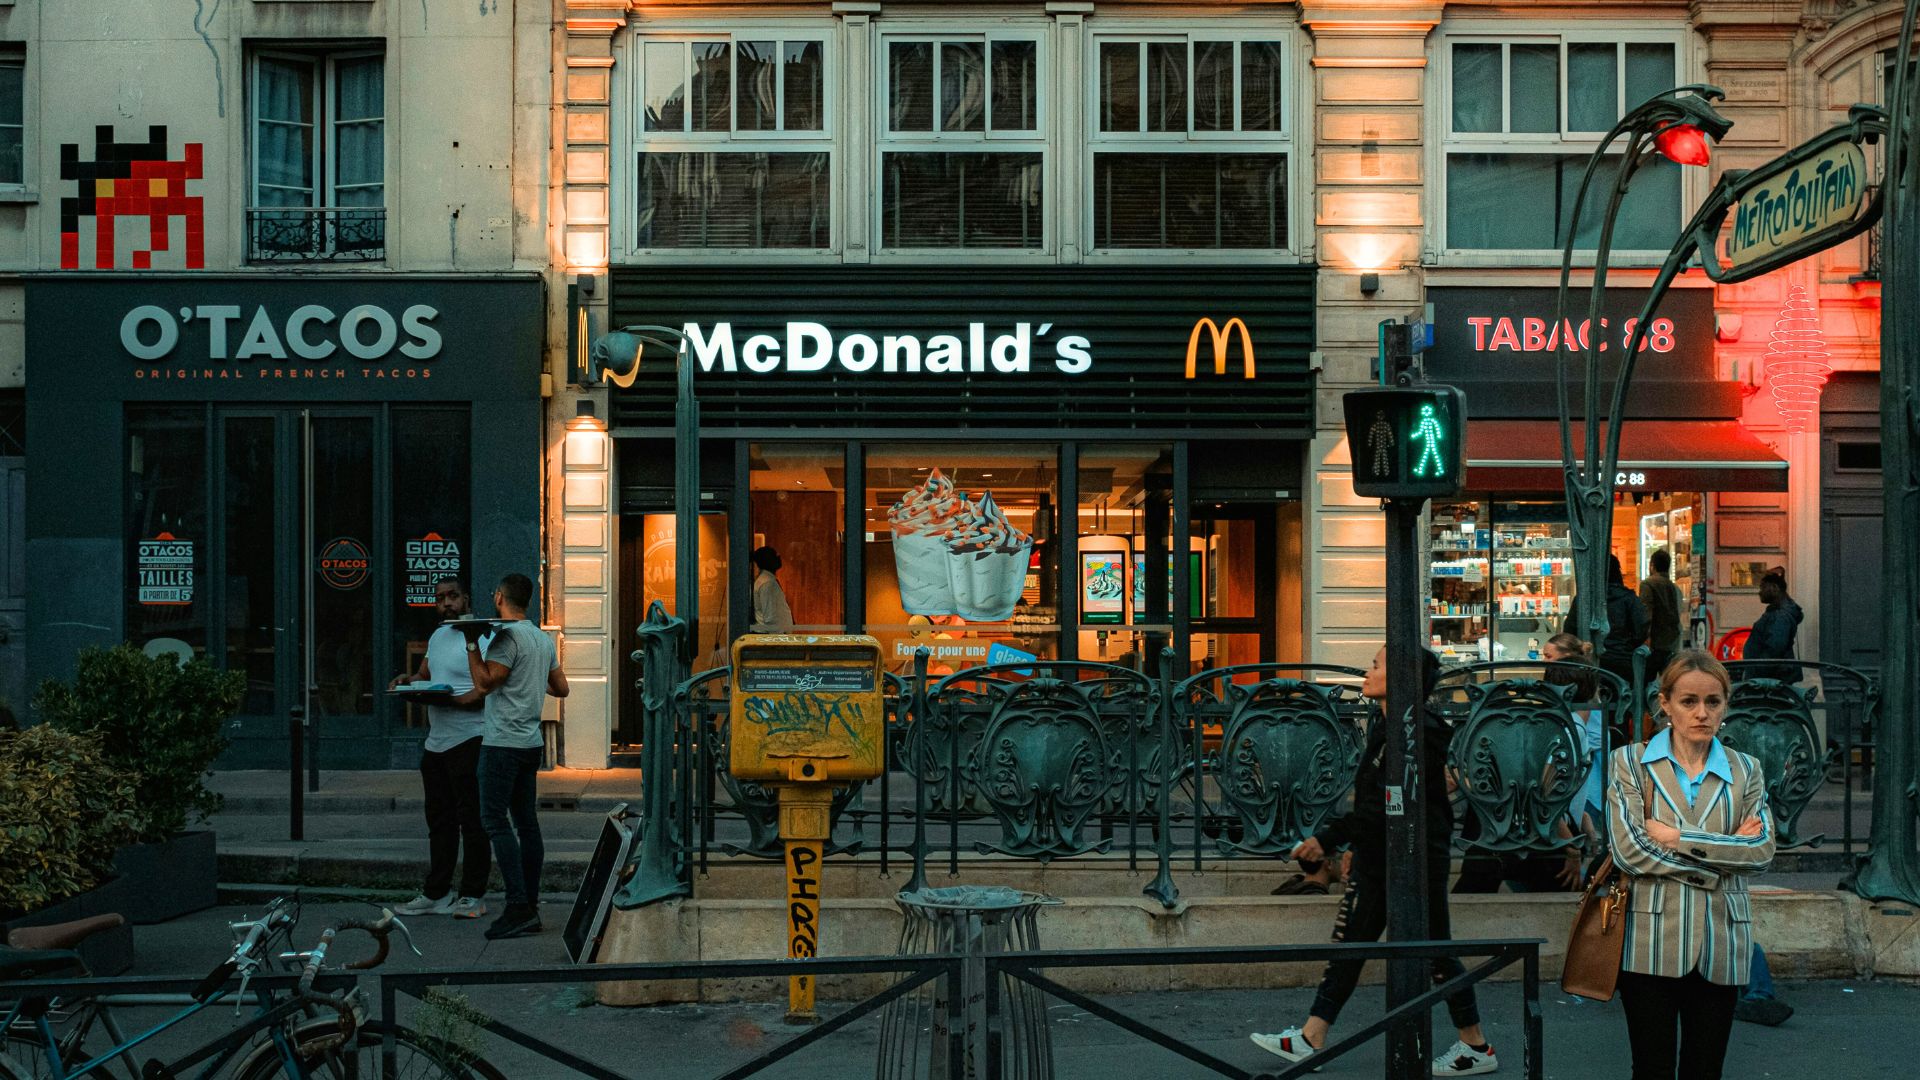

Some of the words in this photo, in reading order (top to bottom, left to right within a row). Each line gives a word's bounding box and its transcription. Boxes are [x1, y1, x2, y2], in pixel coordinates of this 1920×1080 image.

[1733, 151, 1857, 253] METROPOLITAIN
[120, 304, 443, 360] O'TACOS
[1467, 317, 1608, 352] TABAC
[1624, 317, 1676, 353] 88
[135, 369, 243, 379] ORIGINAL
[260, 369, 346, 379] FRENCH
[362, 369, 431, 379] TACOS
[1629, 472, 1645, 485] 88
[139, 546, 193, 556] O'TACOS
[406, 541, 460, 555] GIGA
[406, 558, 460, 570] TACOS
[139, 571, 193, 586] TAILLES
[897, 643, 935, 655] Fonz
[938, 645, 962, 659] pour
[966, 646, 986, 656] une
